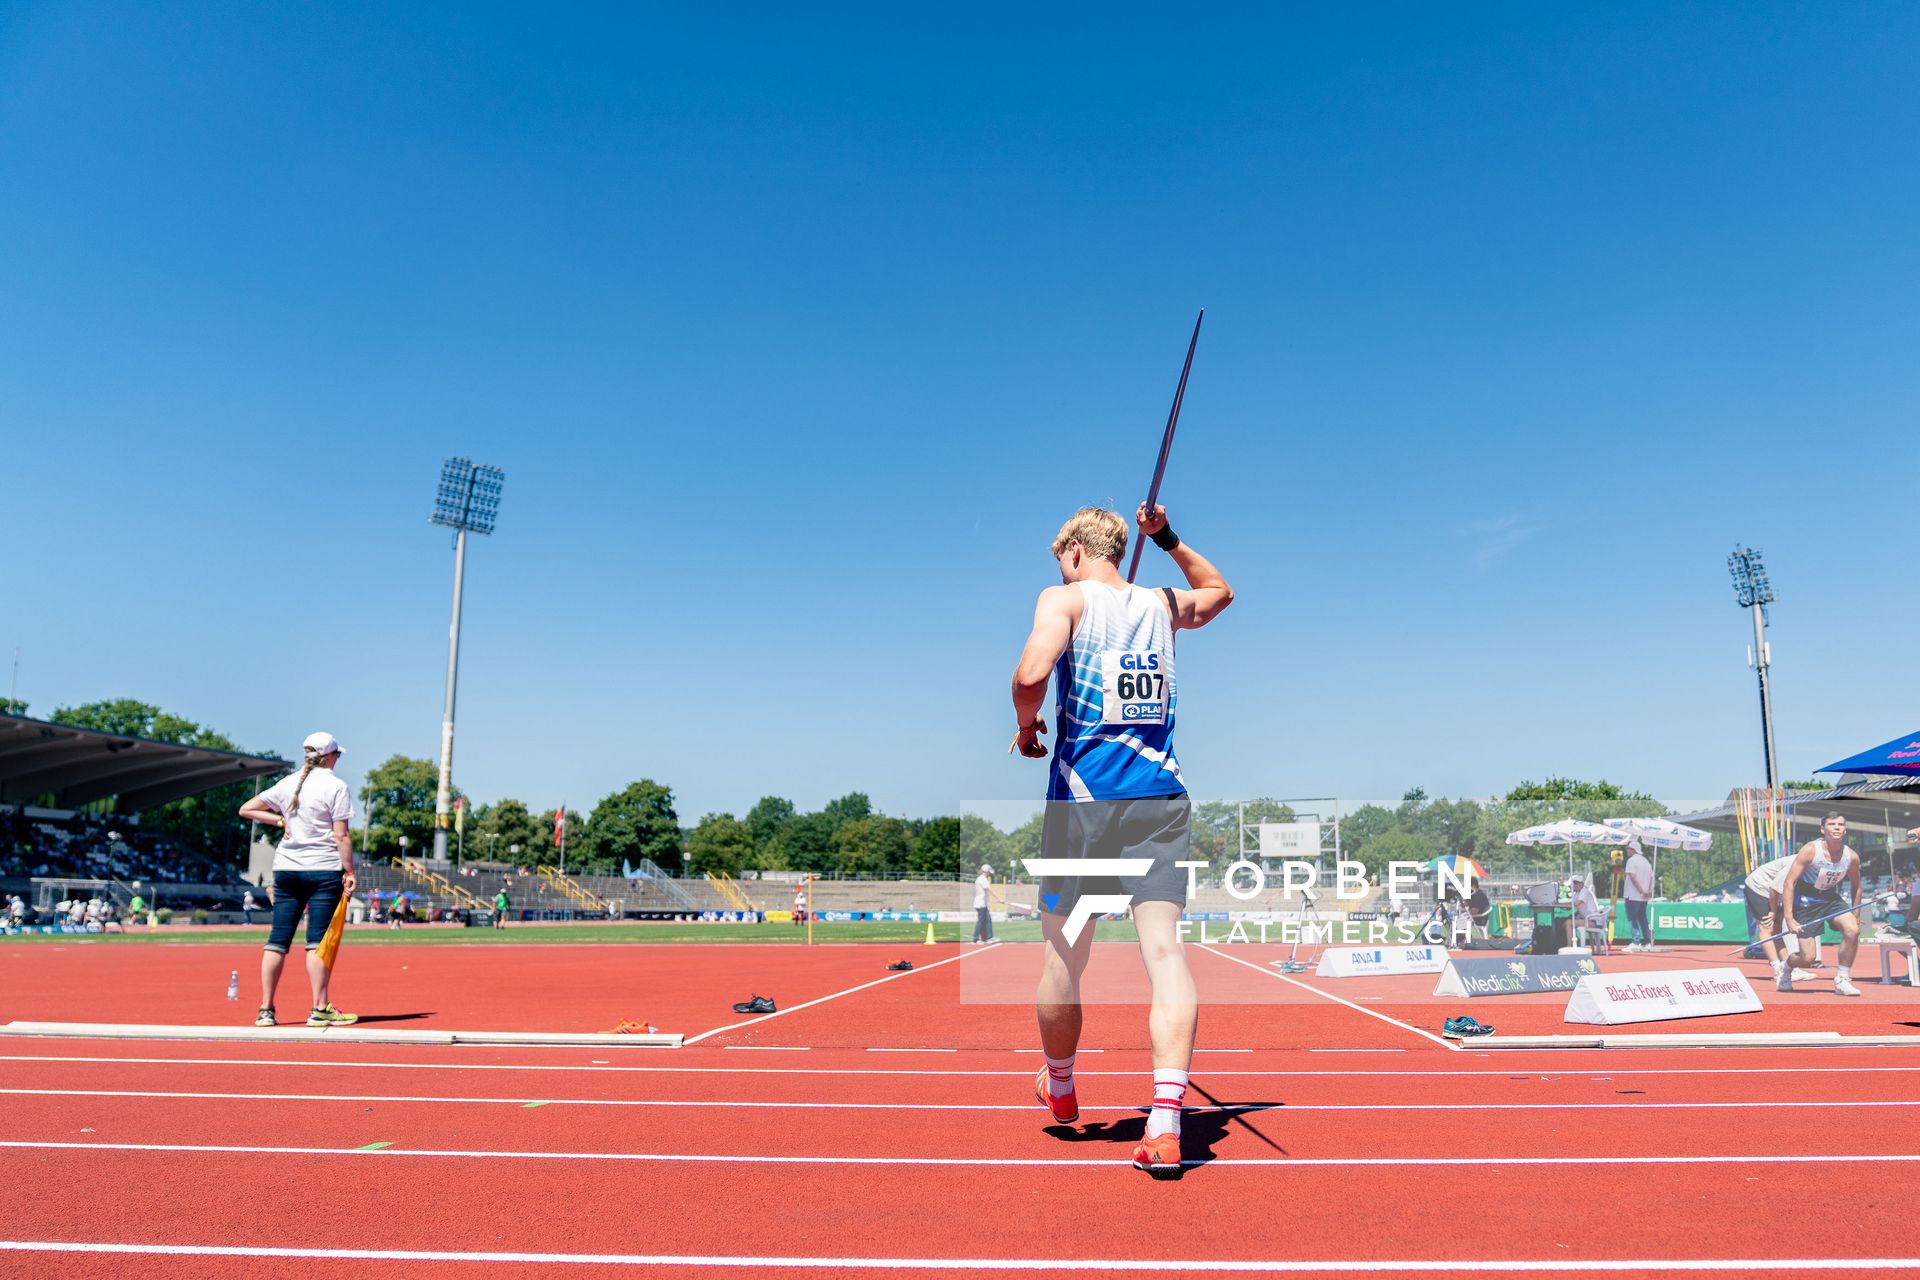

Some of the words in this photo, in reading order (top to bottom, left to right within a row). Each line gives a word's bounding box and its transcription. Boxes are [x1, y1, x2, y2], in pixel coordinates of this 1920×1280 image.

[1119, 653, 1159, 671] GLS
[1117, 672, 1164, 700] 607
[1658, 916, 1719, 929] BENZ
[1352, 952, 1374, 964] ANA
[1406, 950, 1426, 961] ANA
[1462, 974, 1524, 992] Mediclix
[1537, 971, 1580, 989] Medic
[1709, 979, 1744, 995] Forest
[1605, 984, 1641, 1001] Black
[1637, 984, 1674, 998] Forest
